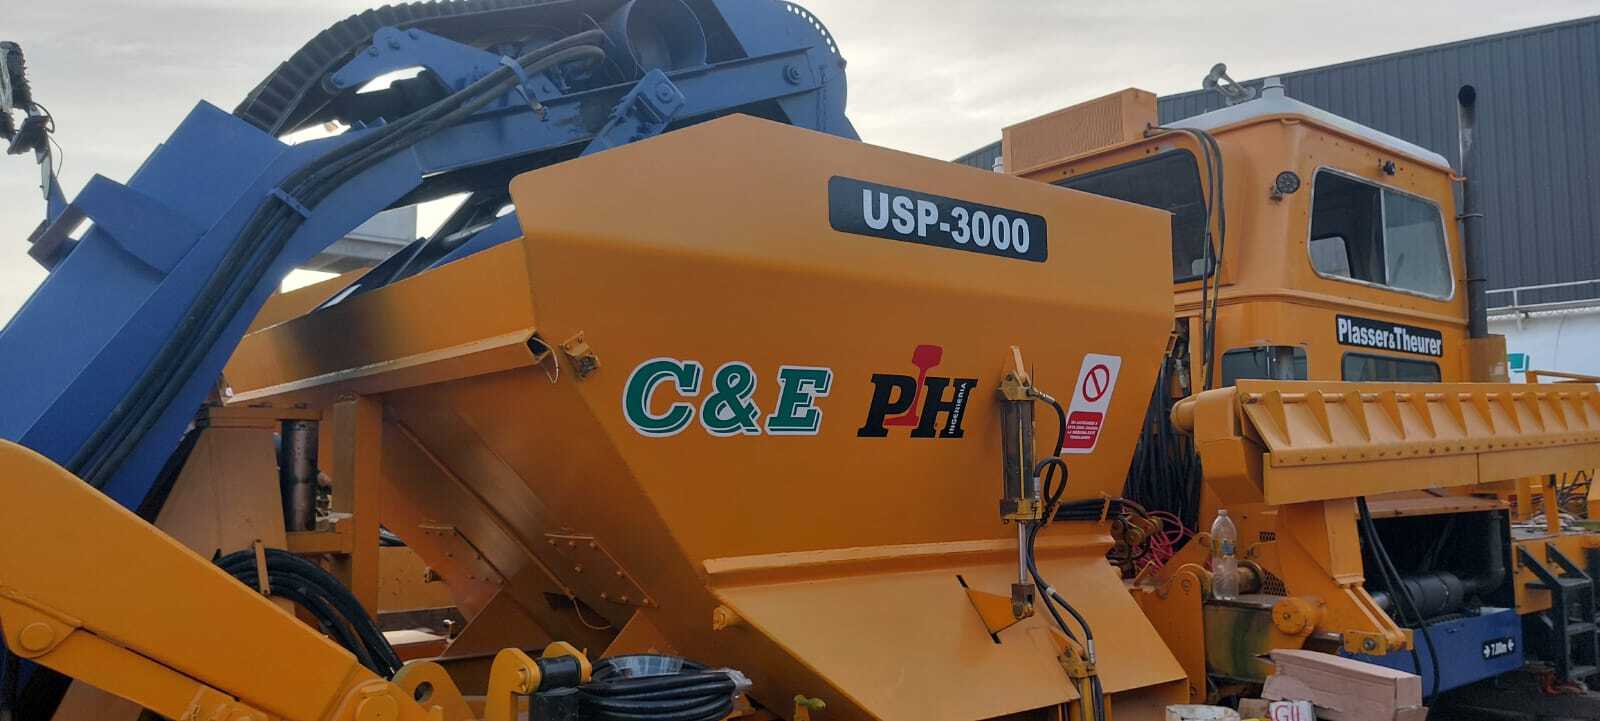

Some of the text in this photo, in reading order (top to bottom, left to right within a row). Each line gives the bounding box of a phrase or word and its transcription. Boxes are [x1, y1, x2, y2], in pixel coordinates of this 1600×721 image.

[862, 189, 1030, 254] USP-3000
[1337, 318, 1442, 355] Plasser&Theurer
[624, 358, 832, 436] C&E
[948, 382, 967, 434] INGENIERIA
